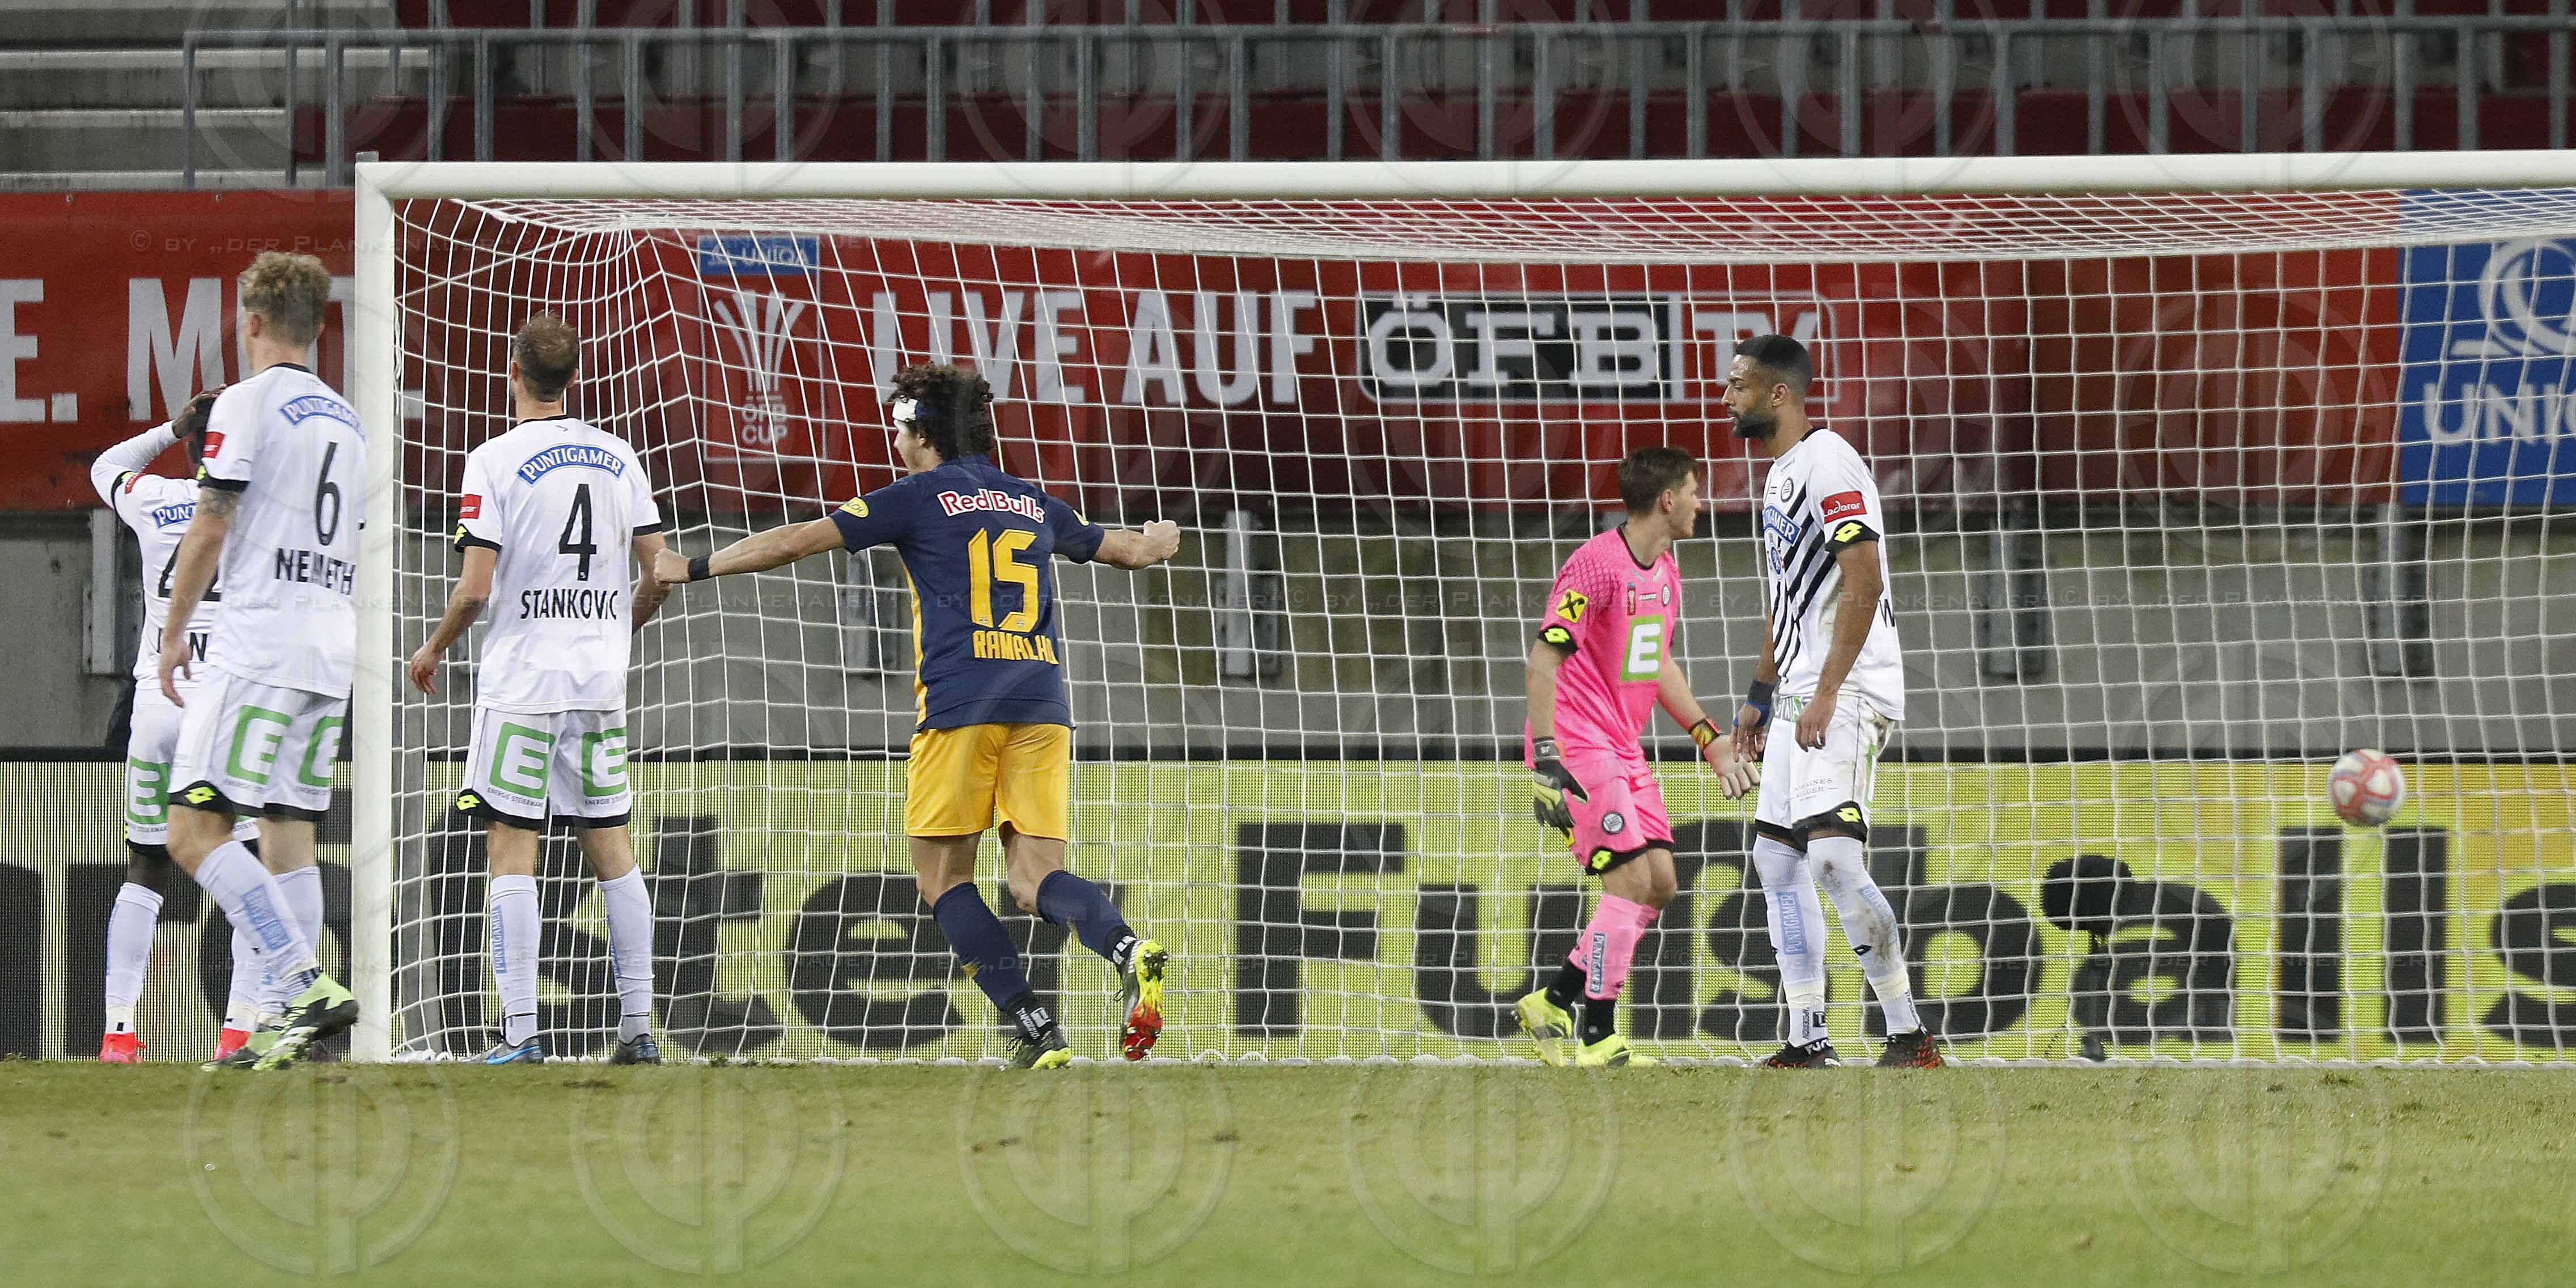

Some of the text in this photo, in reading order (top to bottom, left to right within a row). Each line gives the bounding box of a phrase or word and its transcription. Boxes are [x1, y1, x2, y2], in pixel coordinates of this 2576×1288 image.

[872, 291, 1085, 405] LIVE
[1121, 290, 1316, 406] AUF
[1368, 294, 1658, 388] ÖFB
[741, 425, 789, 444] CUP
[2424, 383, 2576, 446] UNI
[316, 440, 340, 546] 6
[520, 447, 621, 480] PUNTIGAMER
[558, 484, 597, 581] 4
[520, 588, 618, 621] STANKOVIC
[968, 527, 1039, 633] 15
[1622, 616, 1664, 680] E
[490, 722, 556, 799] E
[1782, 893, 1804, 955] PUNTIGAMER
